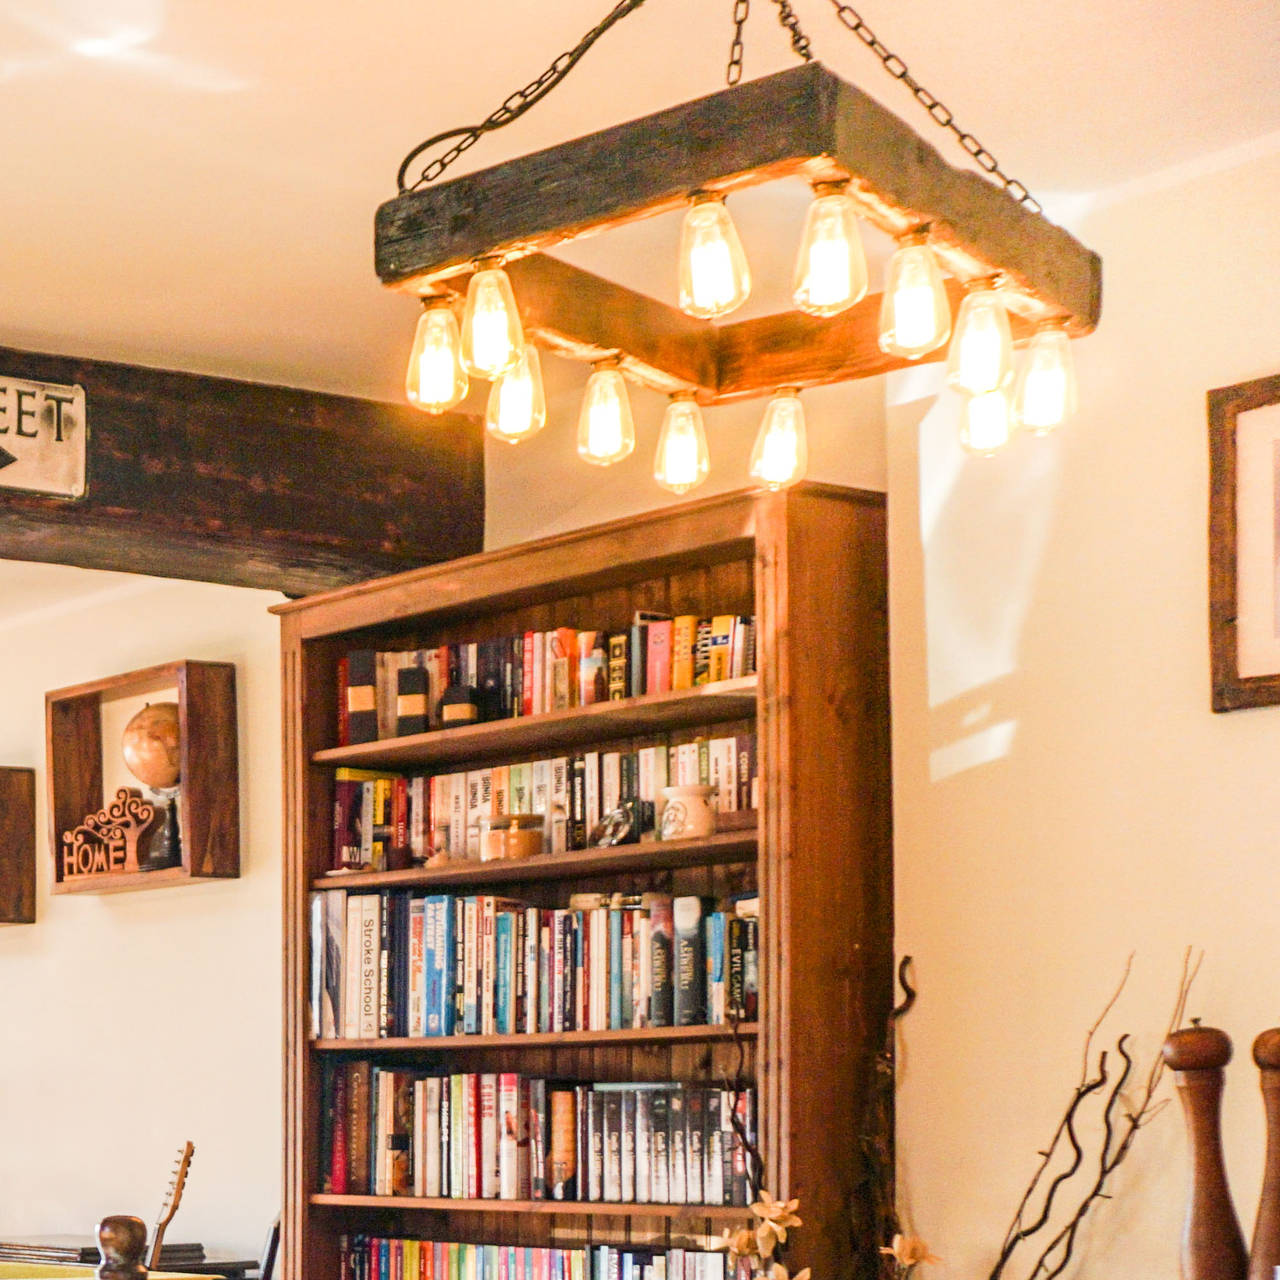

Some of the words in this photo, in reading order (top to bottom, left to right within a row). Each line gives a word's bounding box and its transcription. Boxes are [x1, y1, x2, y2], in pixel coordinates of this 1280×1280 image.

[63, 839, 126, 875] HOME
[364, 919, 374, 965] Stroke
[732, 948, 741, 973] EVIL
[364, 969, 373, 1016] School
